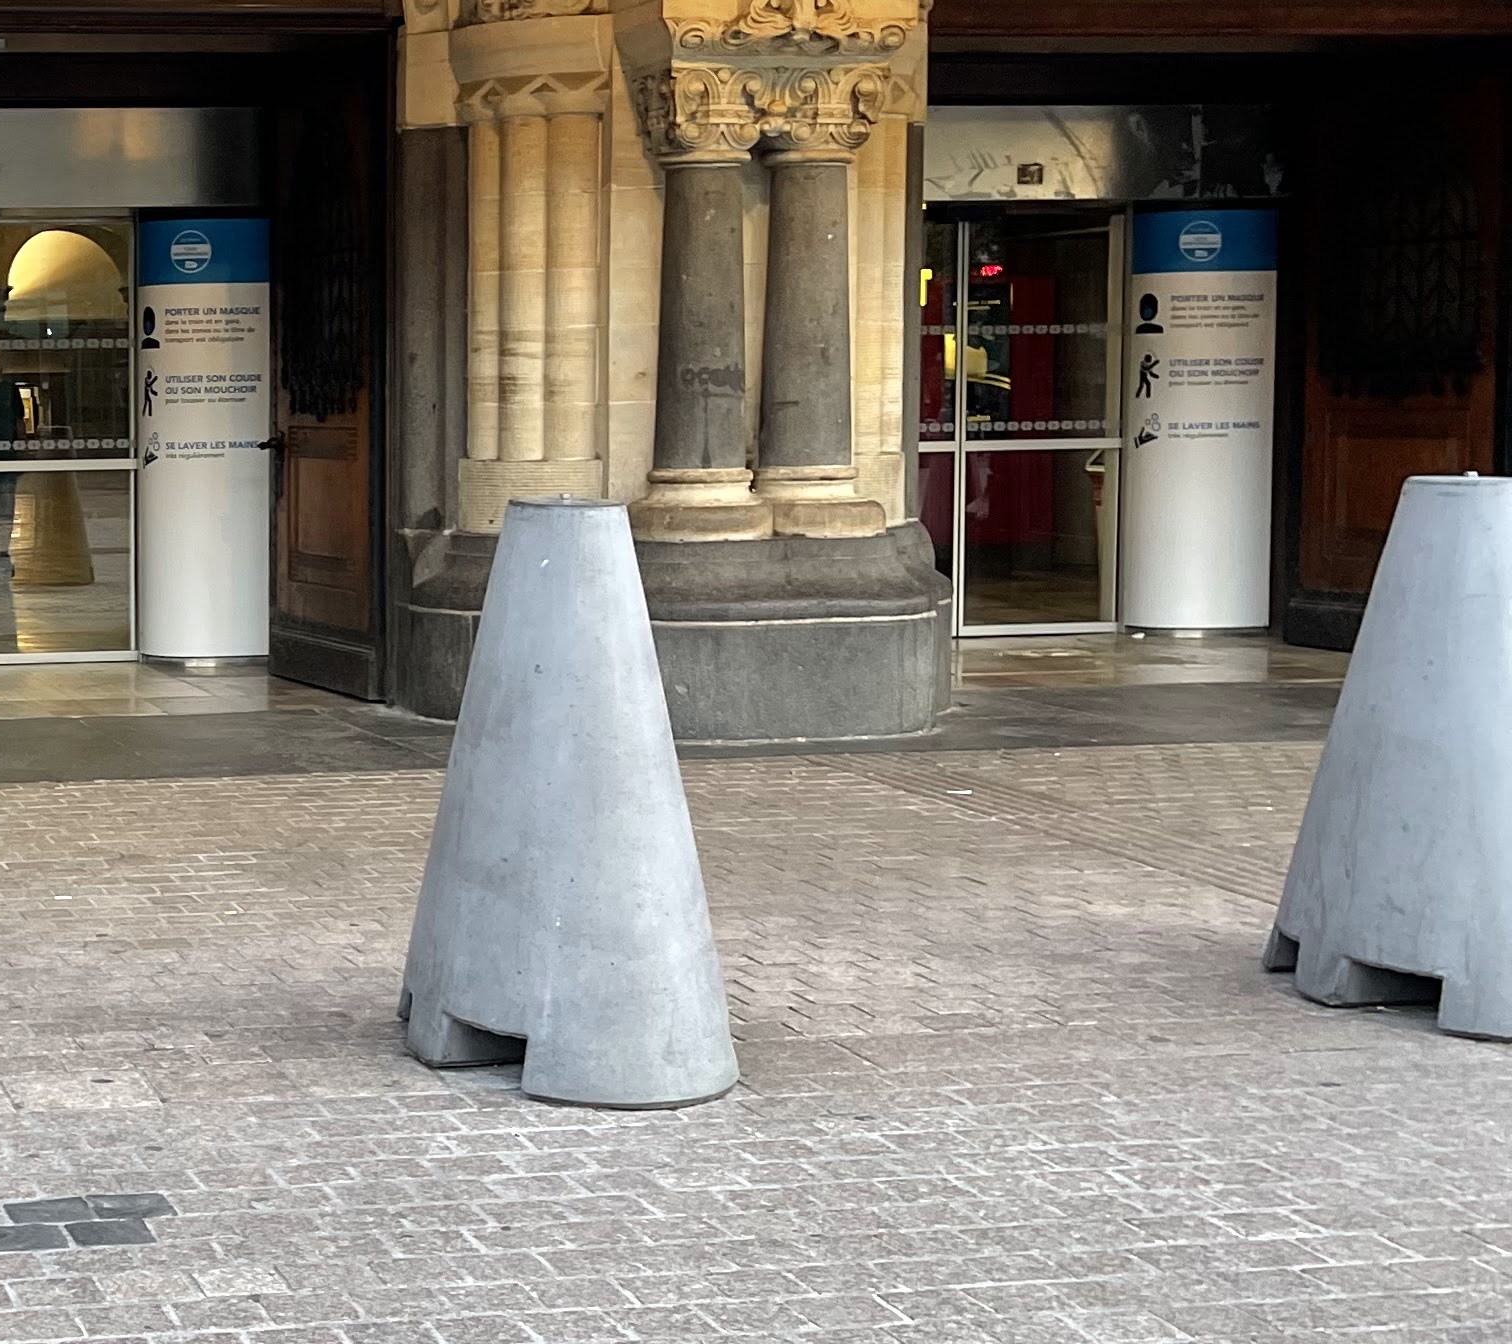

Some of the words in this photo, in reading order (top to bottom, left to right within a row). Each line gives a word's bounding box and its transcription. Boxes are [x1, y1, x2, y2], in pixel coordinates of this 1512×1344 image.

[165, 308, 199, 316] PORTER
[203, 307, 217, 315] UN
[220, 306, 260, 315] MASQUE
[206, 375, 226, 383] SON
[229, 374, 262, 382] COUDE
[210, 441, 226, 449] LES
